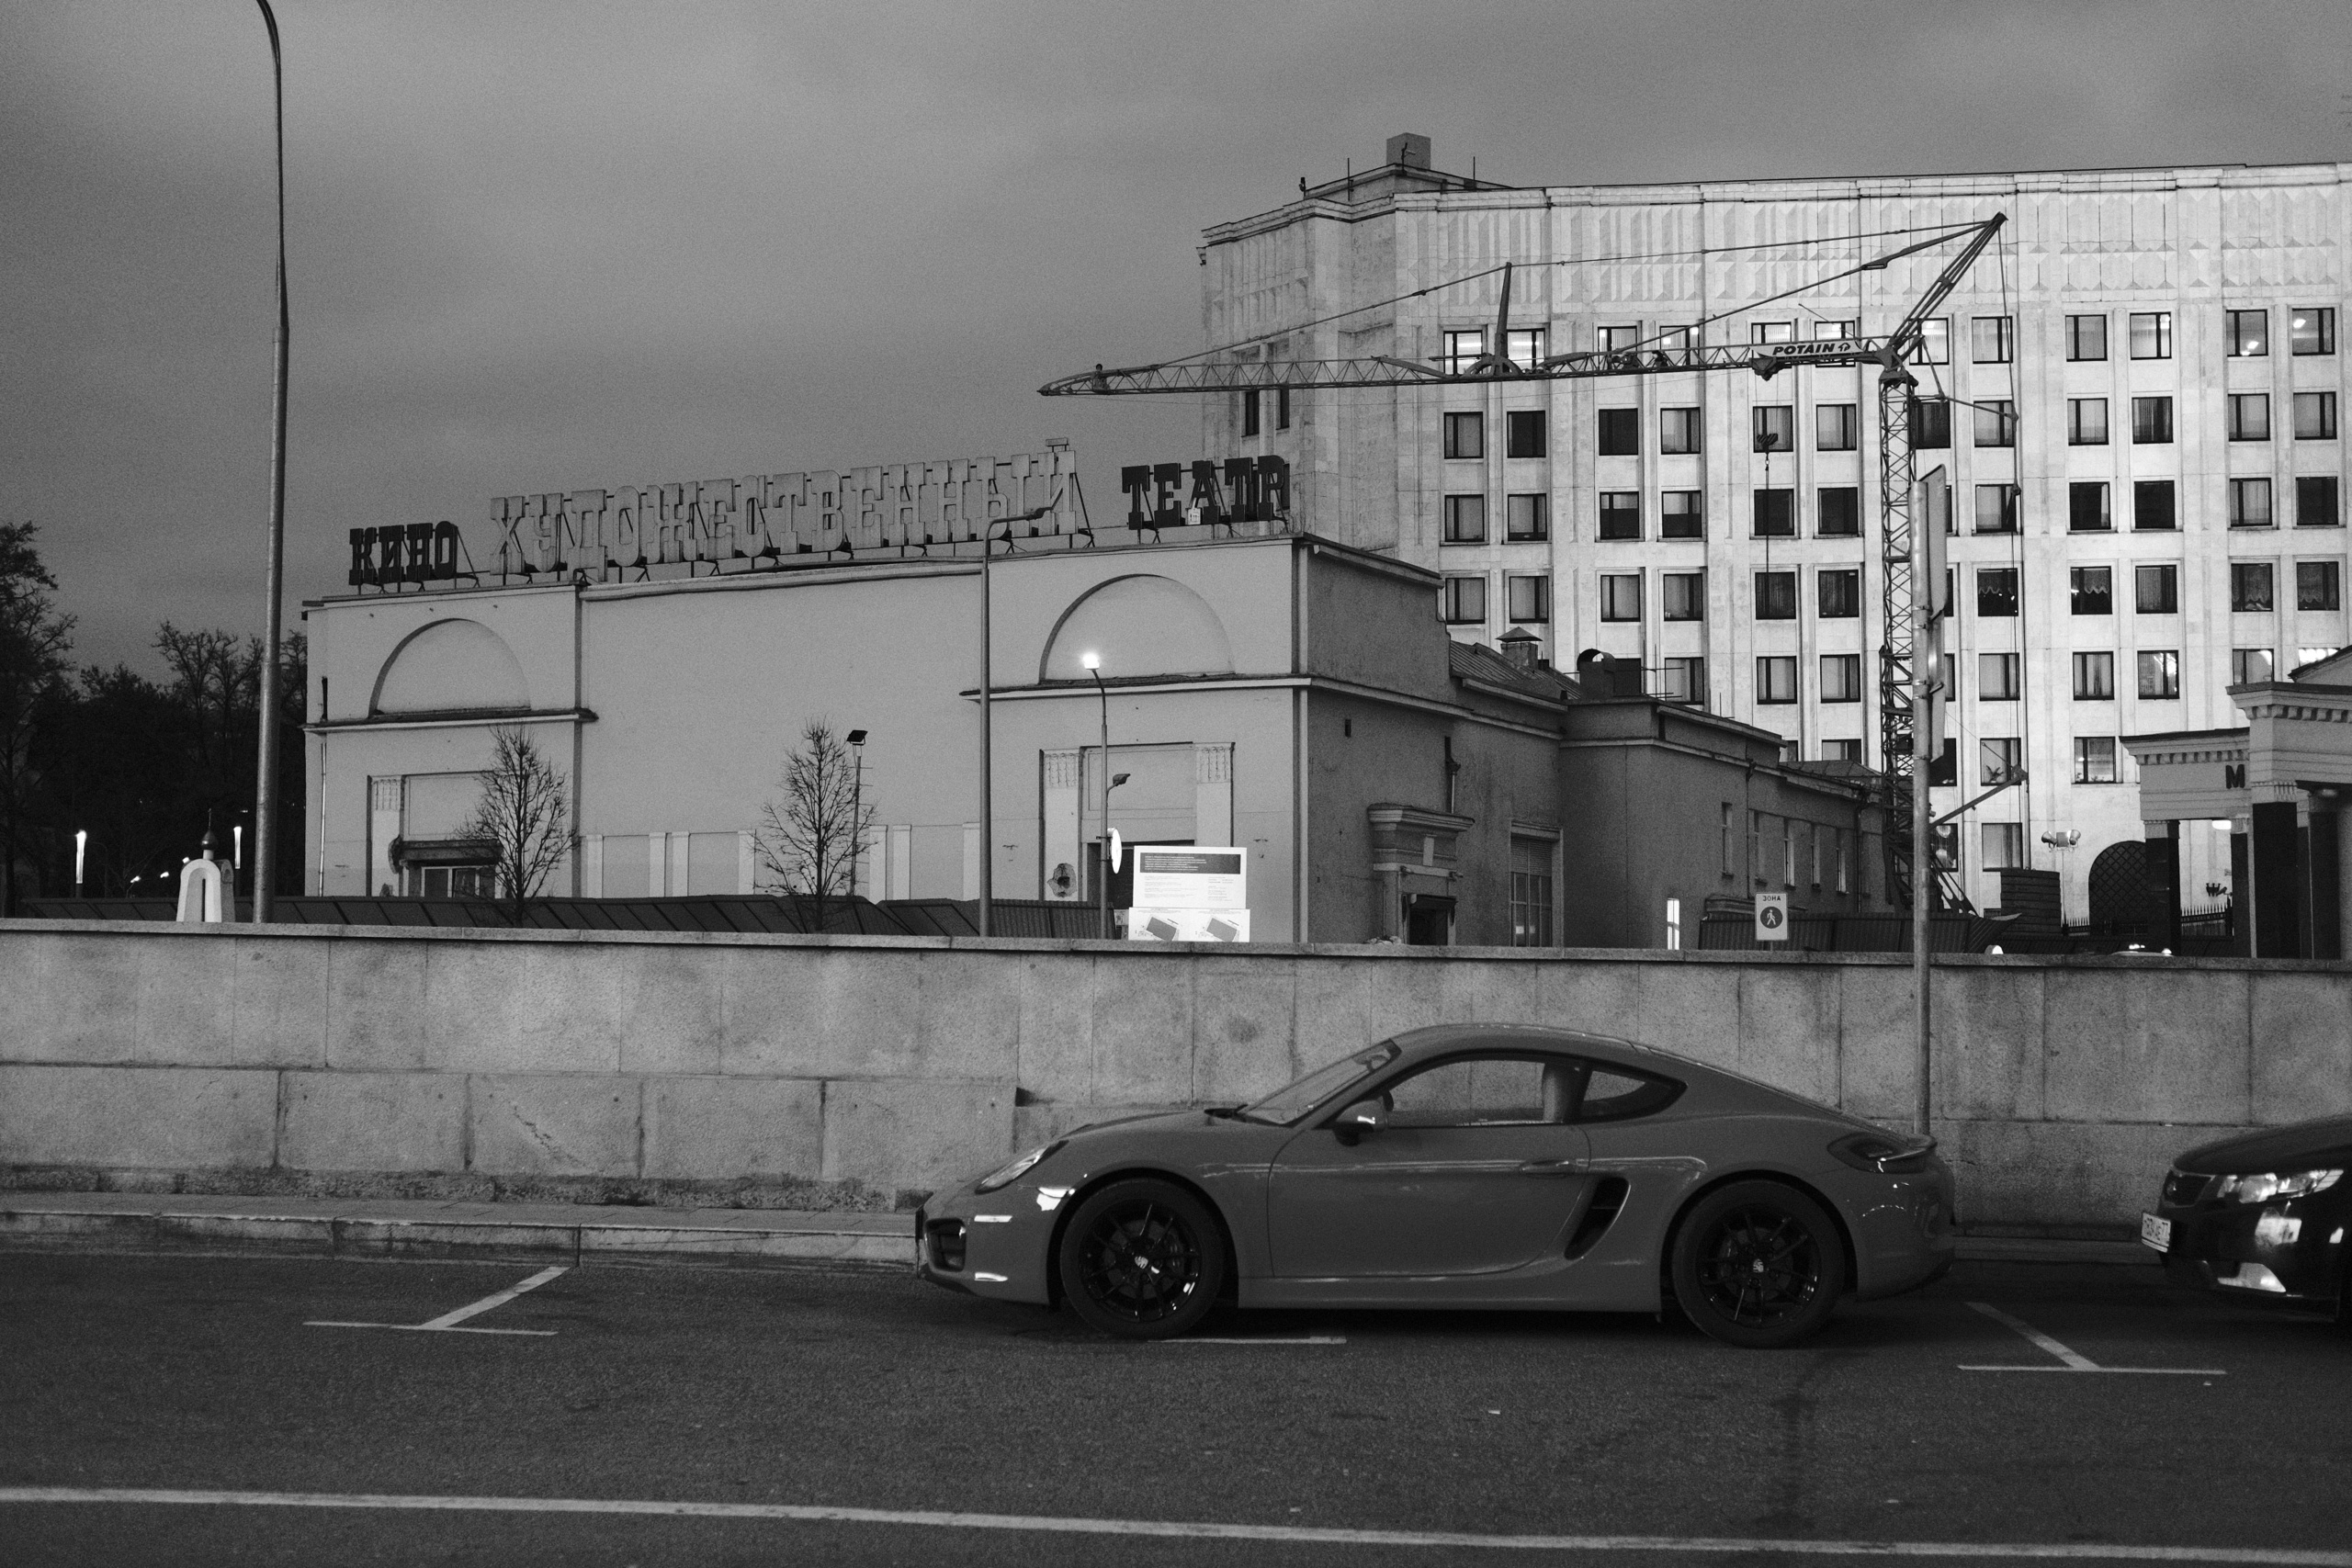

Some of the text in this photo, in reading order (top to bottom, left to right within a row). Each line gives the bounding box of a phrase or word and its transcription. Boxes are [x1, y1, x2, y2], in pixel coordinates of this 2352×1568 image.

[1773, 344, 1835, 355] POTAIN
[348, 437, 1284, 585] КИНО ХУДОЖЕСТВЕННЫЙ ТЕАТР
